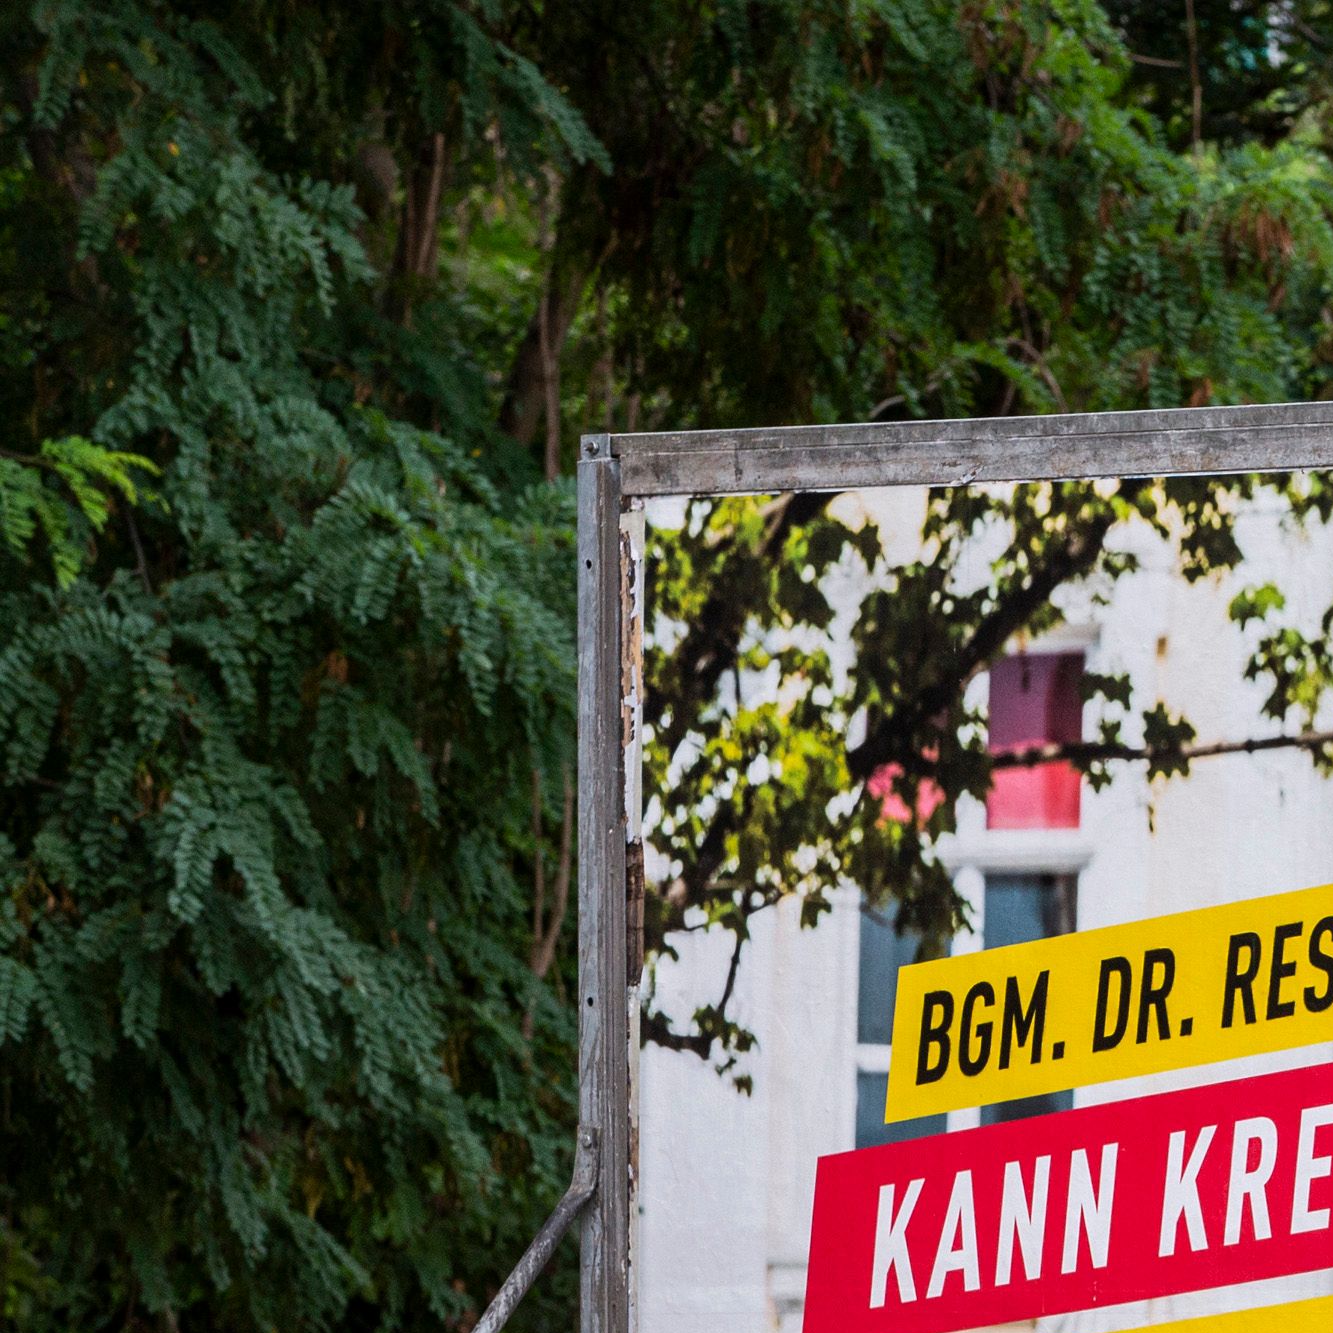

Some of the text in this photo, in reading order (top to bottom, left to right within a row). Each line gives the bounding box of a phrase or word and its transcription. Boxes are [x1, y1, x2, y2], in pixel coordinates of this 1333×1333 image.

[915, 969, 1066, 1086] BGM.
[1092, 948, 1194, 1053] DR.
[869, 1142, 1119, 1310] KANN
